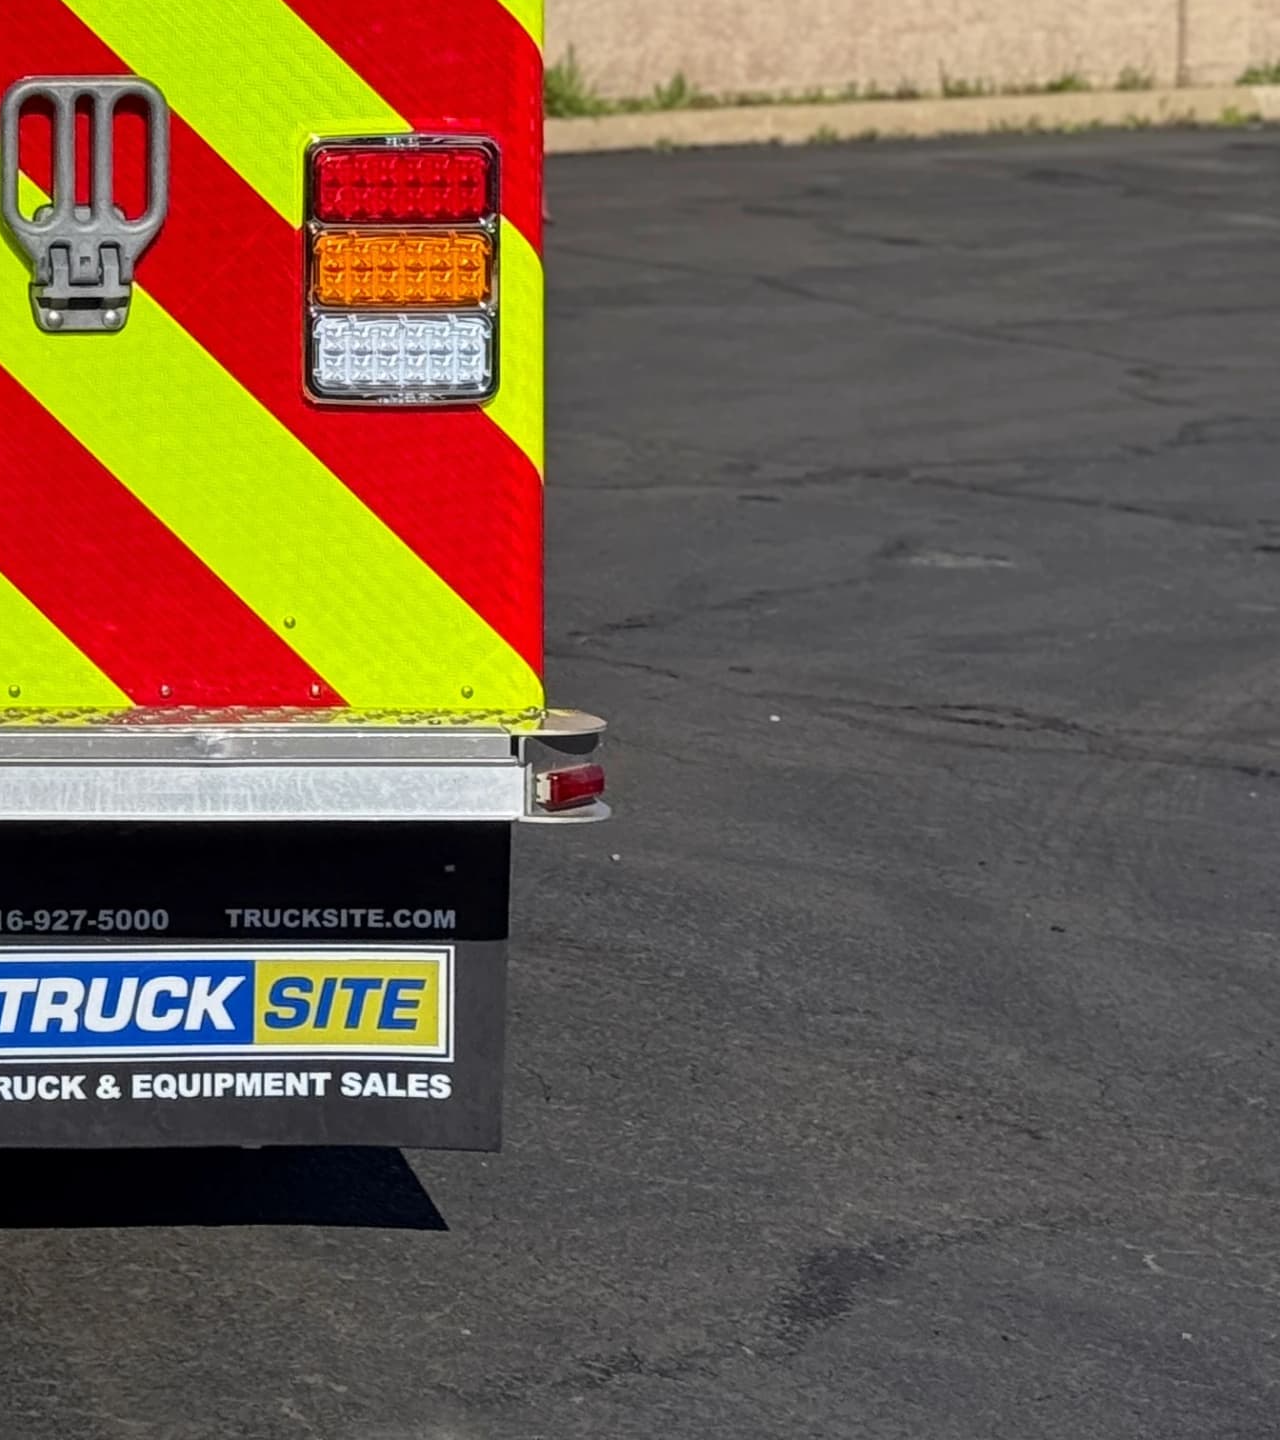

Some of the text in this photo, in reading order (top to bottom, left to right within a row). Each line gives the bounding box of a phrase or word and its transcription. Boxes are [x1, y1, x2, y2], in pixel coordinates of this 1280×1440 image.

[225, 907, 456, 930] TRUCKSITE.COM
[263, 976, 427, 1031] SITE
[95, 1074, 122, 1100] &
[132, 1072, 333, 1099] EQUIPMENT
[339, 1072, 452, 1099] SALES
